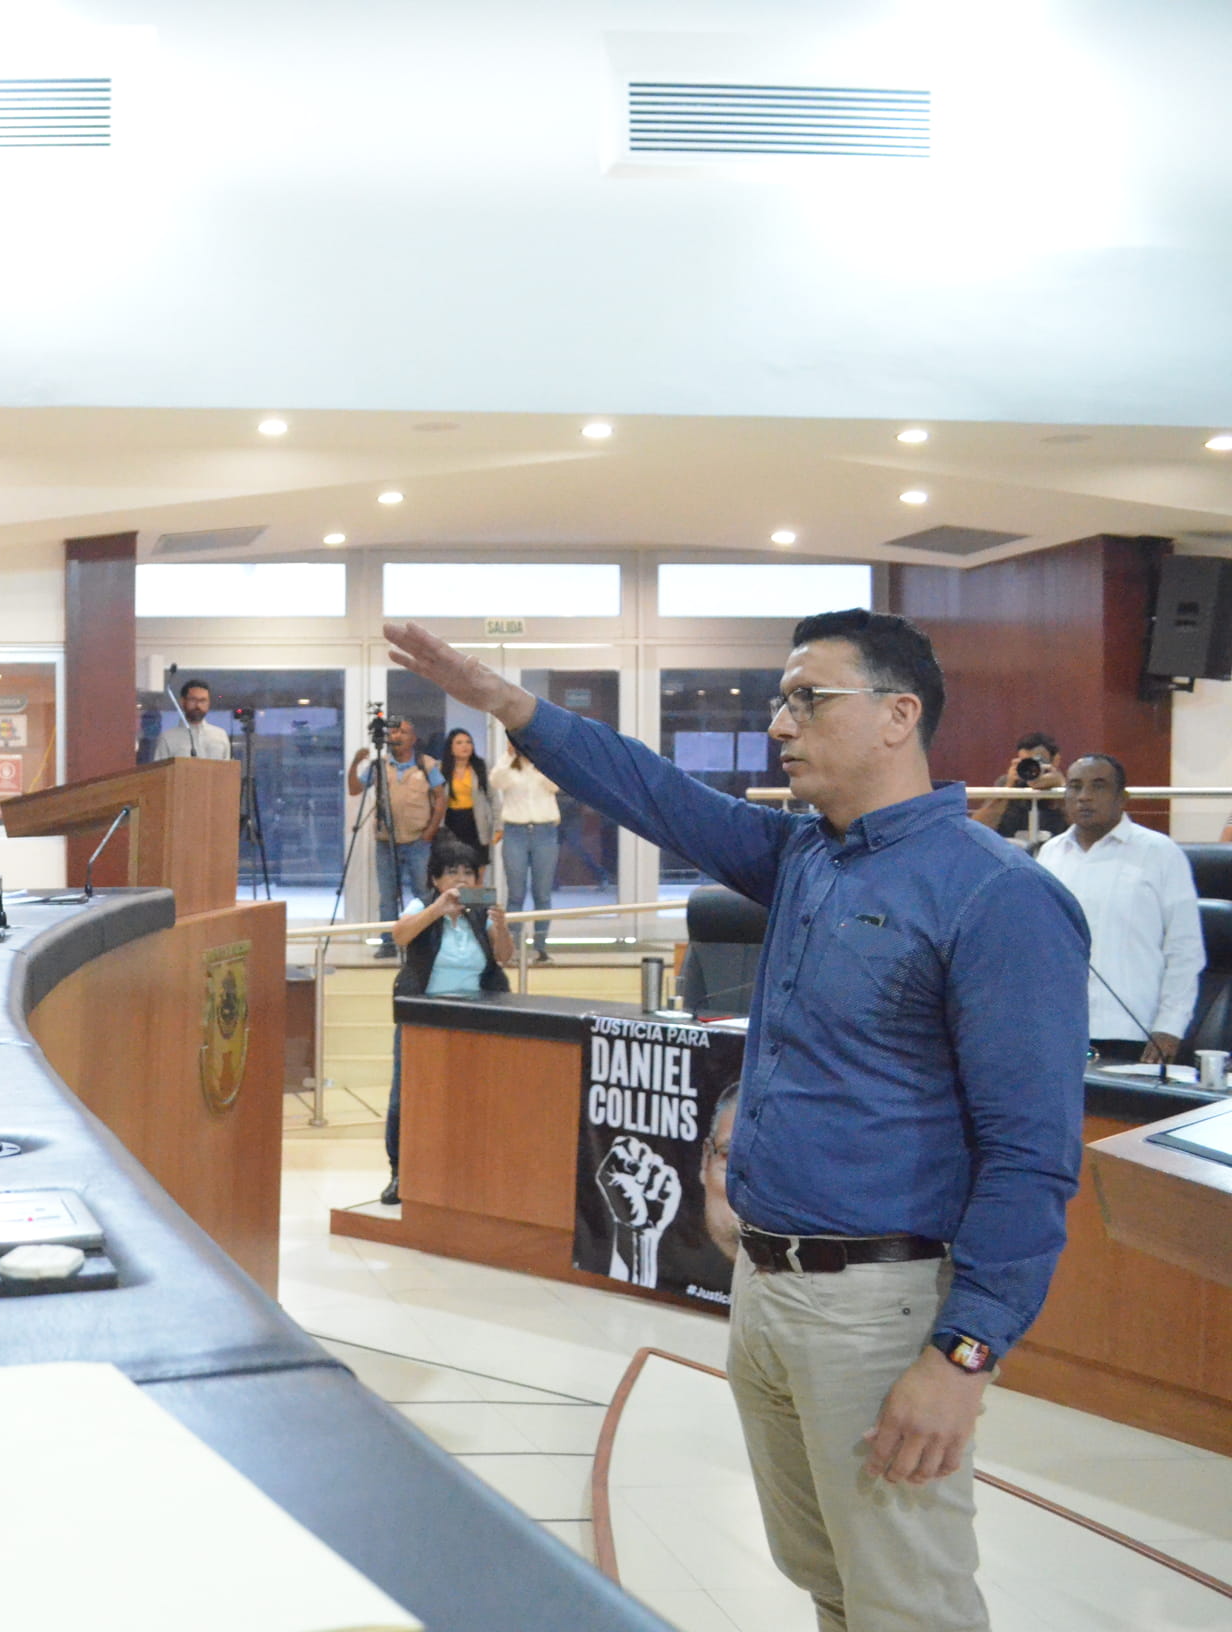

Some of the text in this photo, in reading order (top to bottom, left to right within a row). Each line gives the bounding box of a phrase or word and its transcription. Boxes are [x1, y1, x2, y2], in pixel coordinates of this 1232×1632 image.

[487, 620, 524, 634] SALIDA
[590, 1017, 710, 1048] JUSTICIA PARA
[590, 1035, 697, 1097] DANIEL
[588, 1084, 698, 1142] COLLINS
